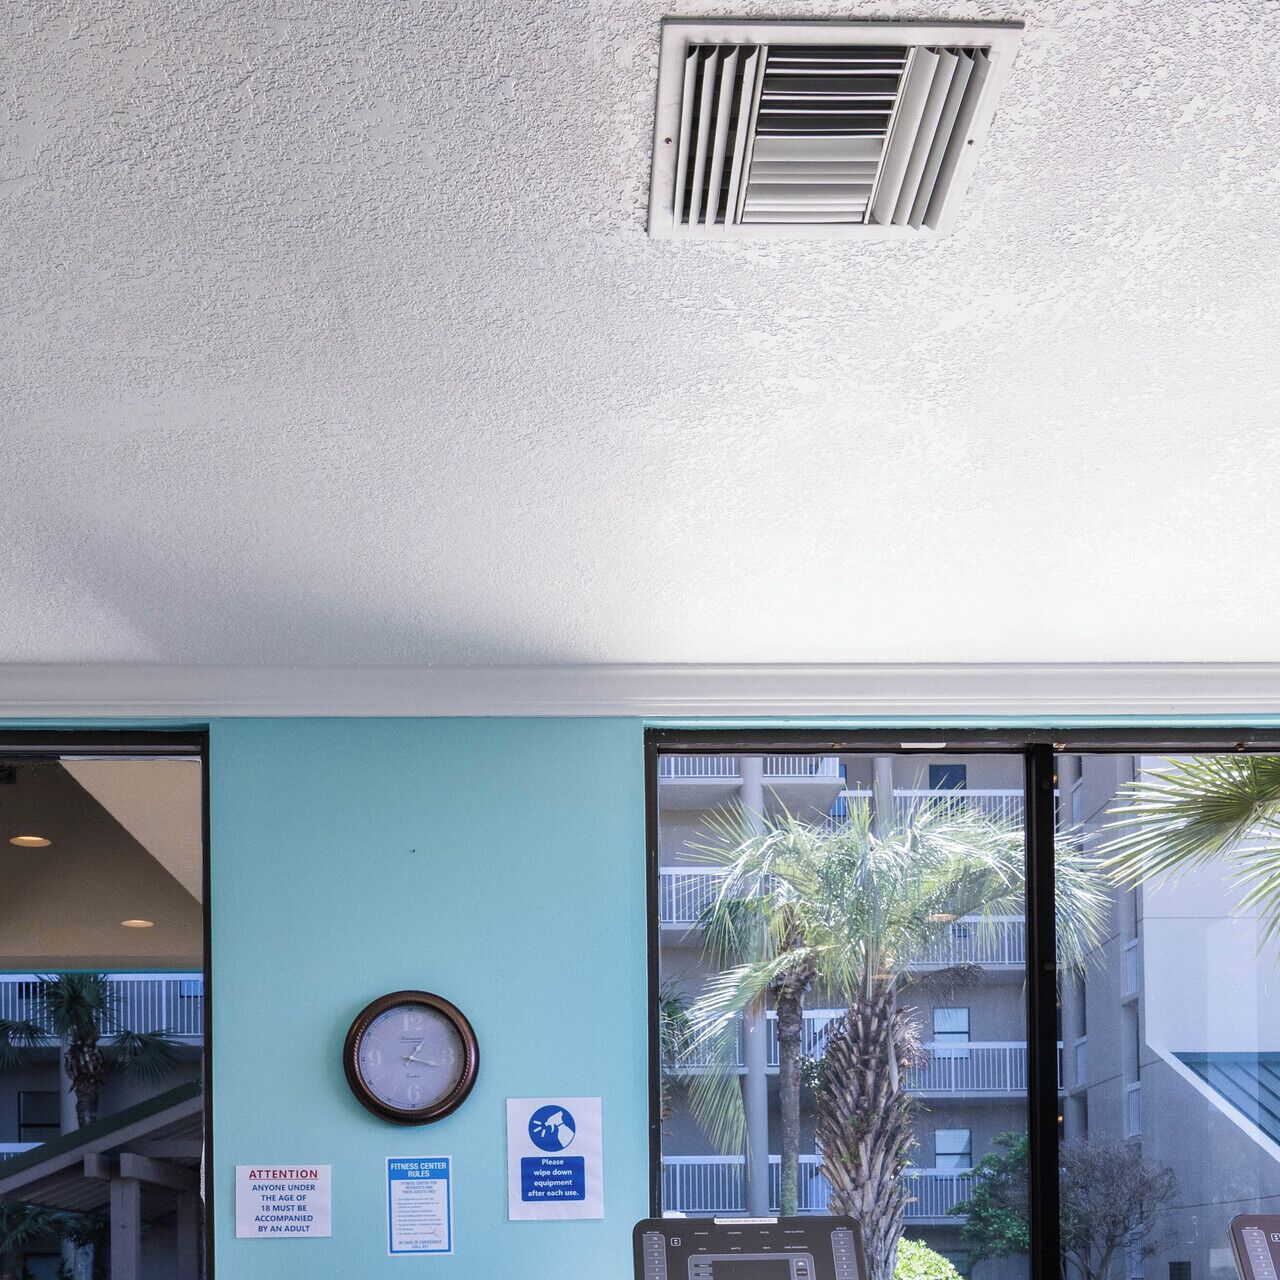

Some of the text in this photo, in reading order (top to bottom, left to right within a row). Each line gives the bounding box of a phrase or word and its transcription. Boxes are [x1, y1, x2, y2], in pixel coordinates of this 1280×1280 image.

[391, 1162, 447, 1170] FITNESS CENTER
[248, 1169, 318, 1179] ATTENTION
[407, 1170, 430, 1178] RULES
[533, 1169, 551, 1177] wipe
[251, 1184, 316, 1192] ANYONE UNDER
[260, 1194, 307, 1202] THE AGE OF
[261, 1204, 307, 1212] 18 MUST BE
